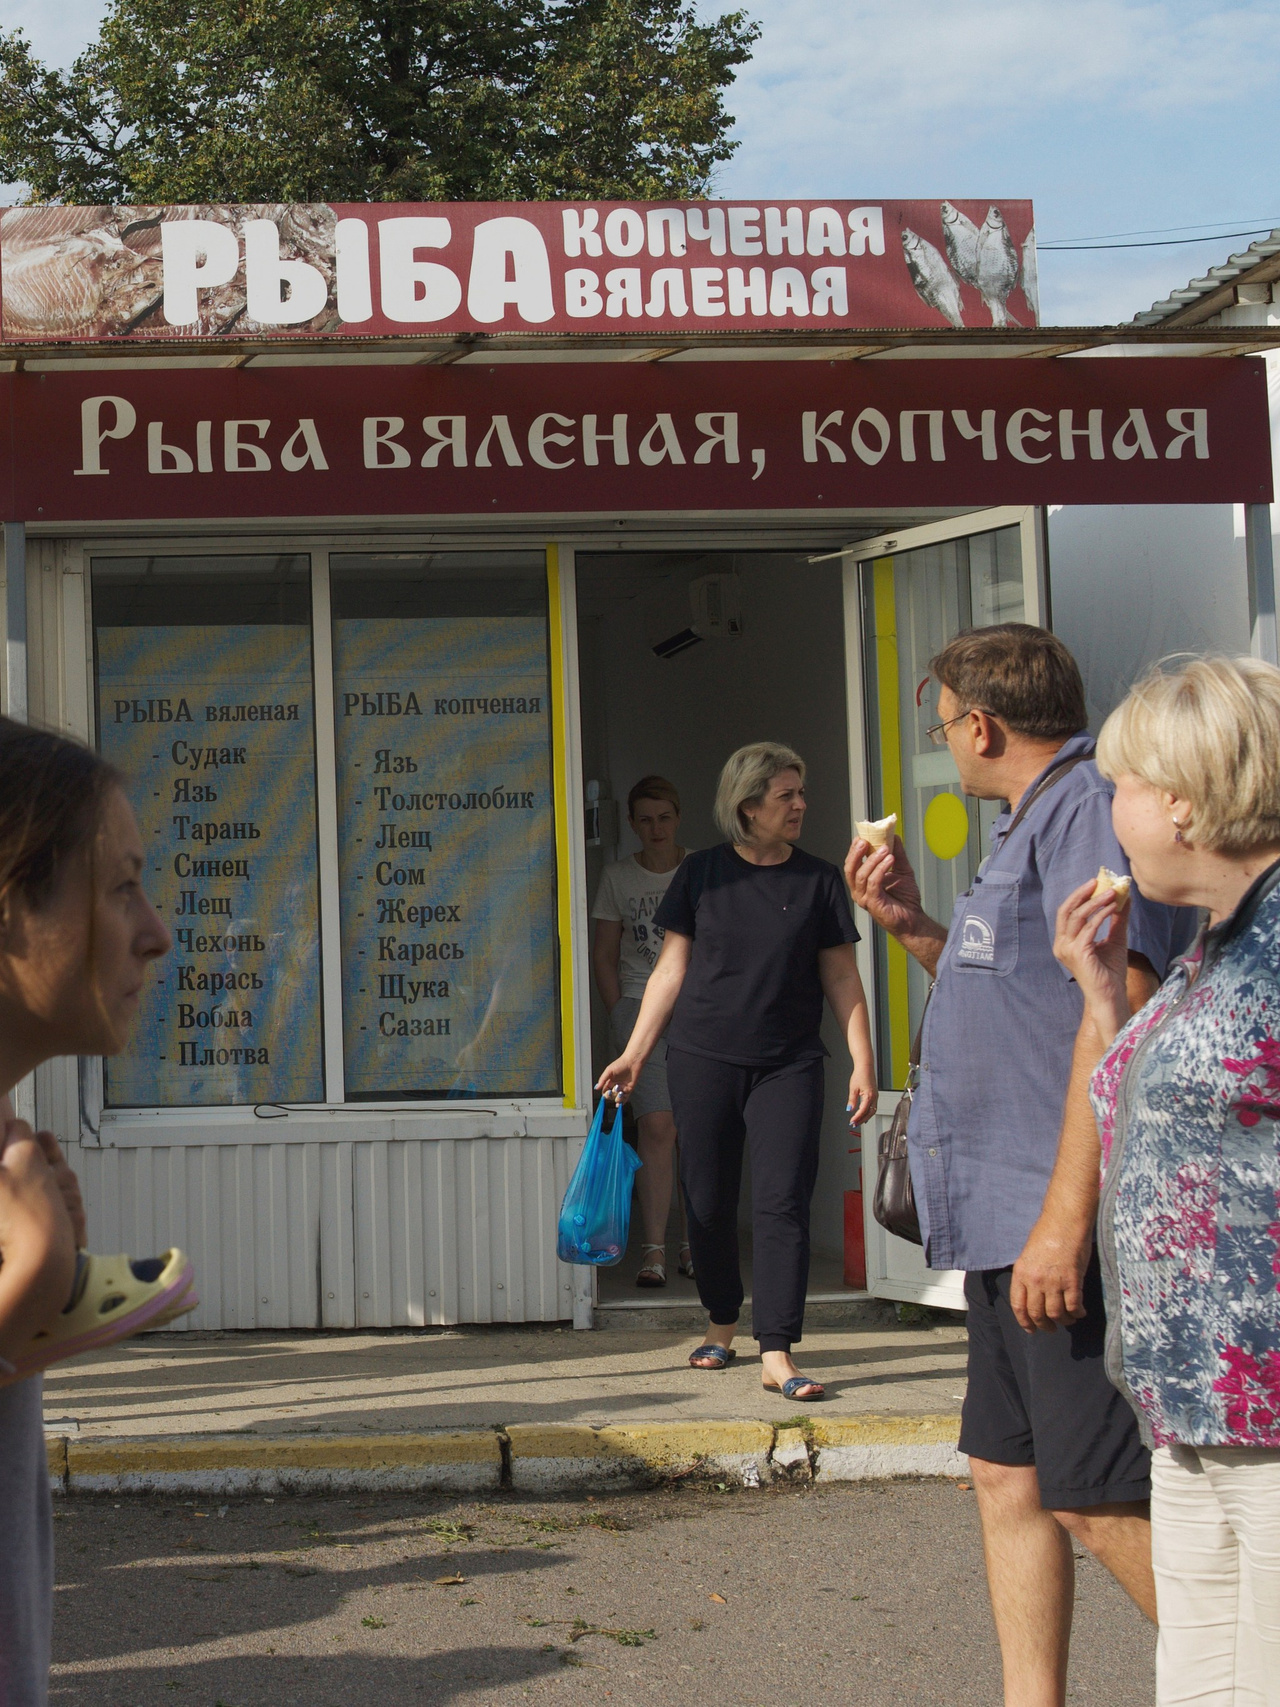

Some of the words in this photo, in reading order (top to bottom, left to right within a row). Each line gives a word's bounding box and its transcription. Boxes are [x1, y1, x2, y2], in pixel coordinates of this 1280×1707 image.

[160, 215, 557, 326] РЫБА
[561, 205, 886, 258] КОПЧЕНАЯ
[563, 266, 849, 318] ВЯЛЕНАЯ
[113, 699, 194, 724] РЫБА
[205, 701, 300, 722] вяленая
[343, 692, 423, 717] РЫБА
[434, 694, 541, 715] копченая
[171, 741, 246, 769] Судак
[373, 749, 418, 774] Язь
[172, 778, 218, 802] Язь
[374, 786, 535, 811] Толстолобик
[173, 816, 261, 844] Тарань
[375, 824, 432, 852] Лещ
[174, 853, 250, 880] Синец
[376, 861, 426, 886] Сом
[175, 891, 233, 918] Лещ
[377, 899, 461, 928] Жерех
[176, 929, 265, 953] Чехонь
[377, 936, 465, 965] Карась
[637, 942, 657, 965] URB
[177, 966, 264, 994] Карась
[378, 974, 450, 1003] Щука
[178, 1004, 253, 1029] Вобла
[379, 1012, 451, 1037] Сазан
[178, 1042, 270, 1067] Плотва
